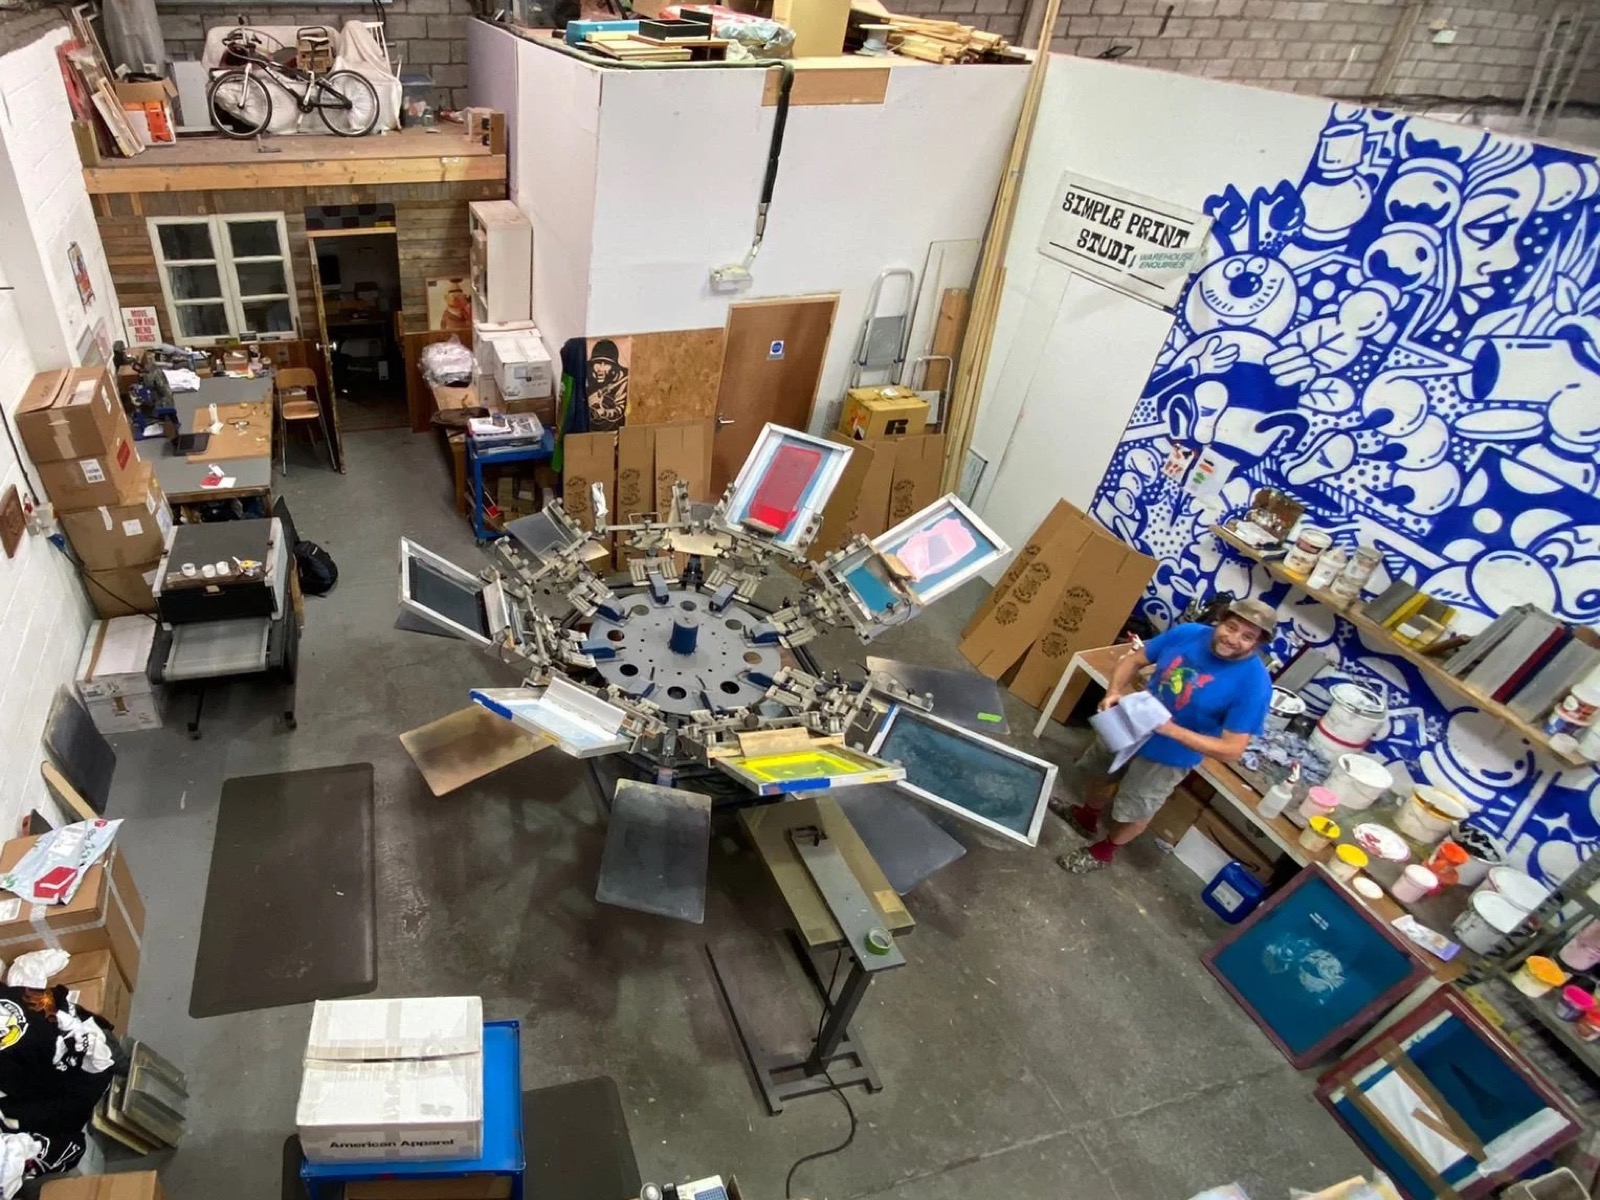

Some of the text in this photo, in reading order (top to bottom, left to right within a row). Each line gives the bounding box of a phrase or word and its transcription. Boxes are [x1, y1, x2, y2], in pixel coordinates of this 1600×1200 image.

[1062, 191, 1190, 249] SIMPLE PRINT
[1077, 228, 1138, 268] STUDI
[1139, 252, 1196, 262] WAREHOUSE
[1138, 261, 1186, 269] ENQUIRIES
[330, 1139, 454, 1149] American Apparel
